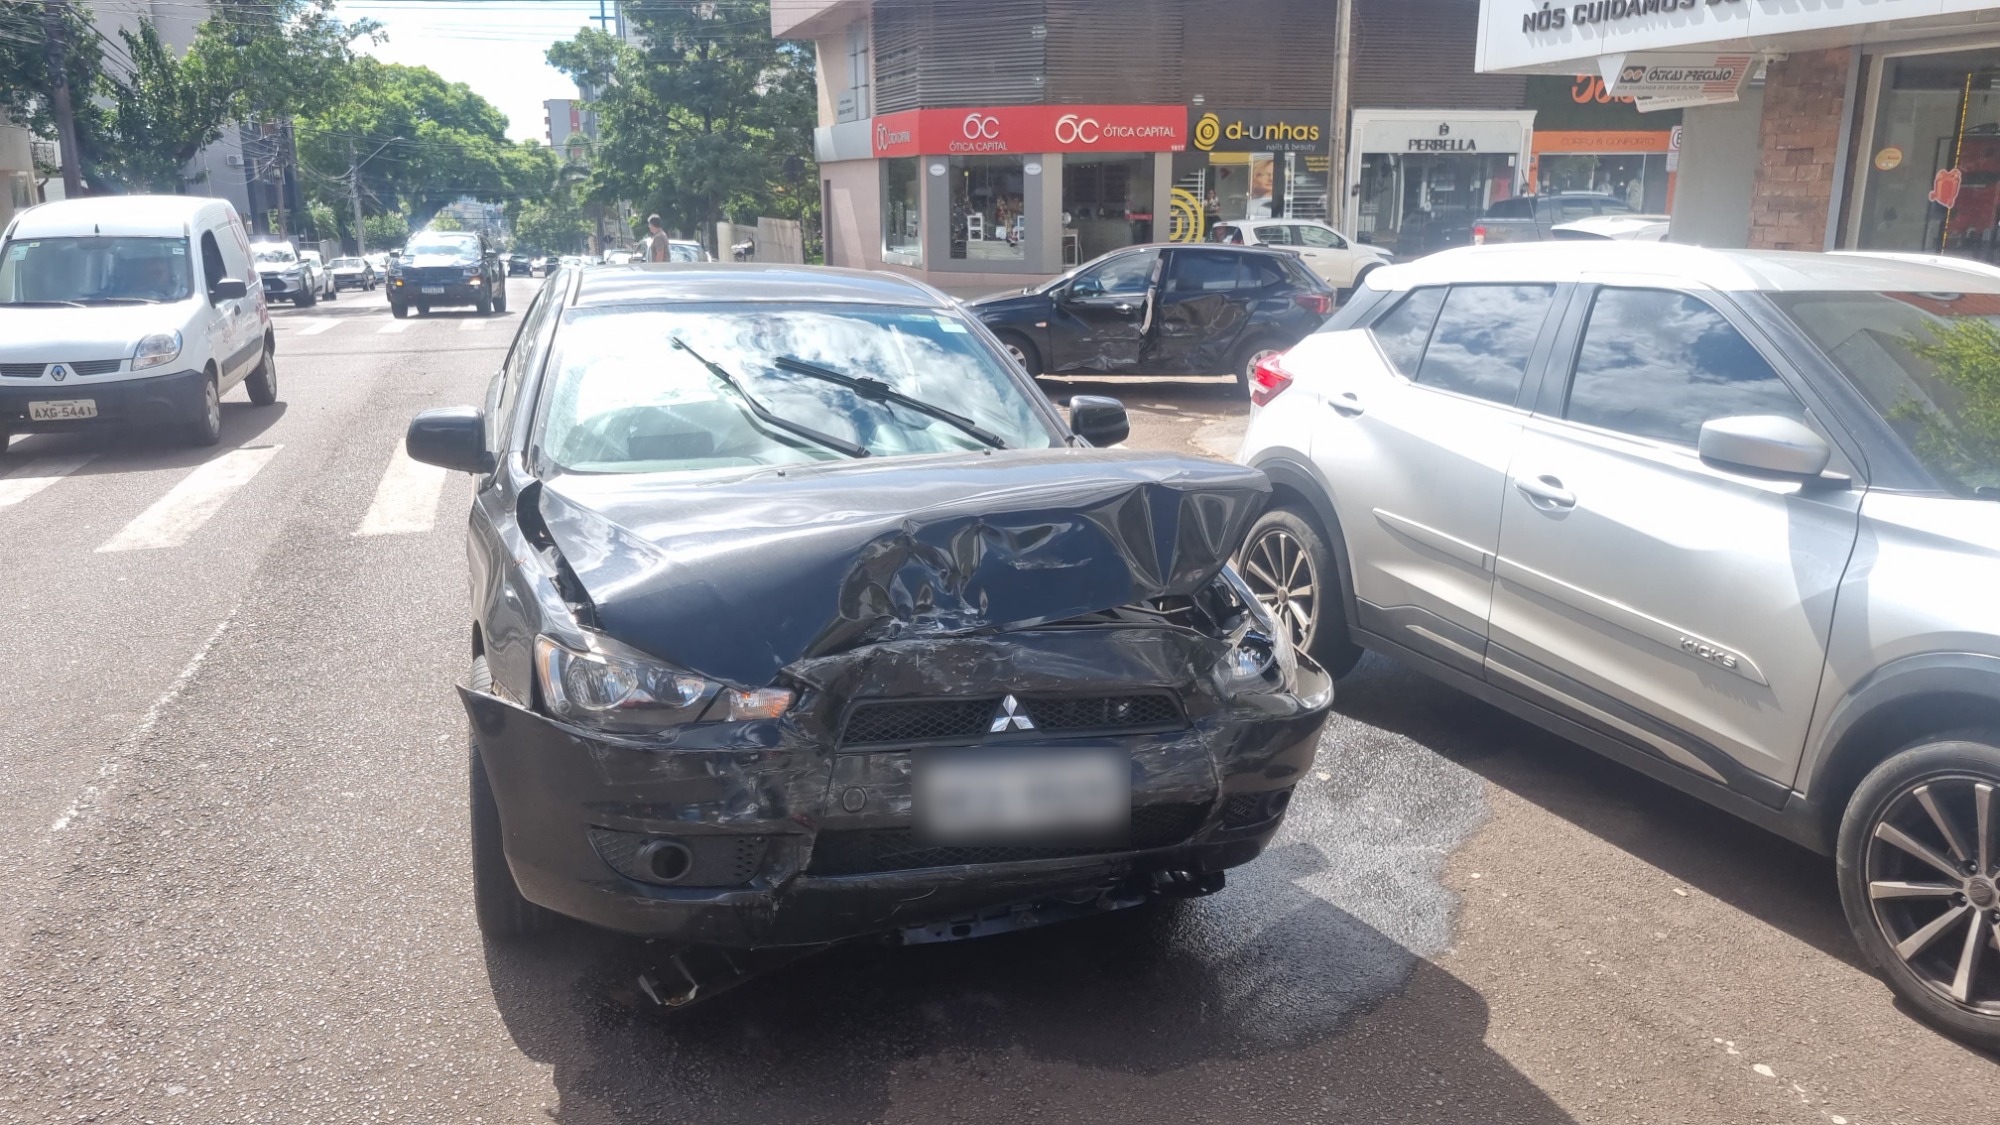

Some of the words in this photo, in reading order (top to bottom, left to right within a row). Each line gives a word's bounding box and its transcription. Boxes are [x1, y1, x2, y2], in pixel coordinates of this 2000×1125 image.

[1522, 2, 1565, 33] NÓS
[1103, 124, 1135, 138] ÓTICA
[1136, 126, 1177, 138] CAPITAL
[1225, 121, 1320, 141] d-unhas
[949, 141, 975, 152] ÓTICA
[975, 141, 1009, 152] CAPITAL
[1291, 143, 1317, 152] beauty
[1408, 139, 1477, 151] PERBELLA
[1680, 637, 1737, 669] KICKS
